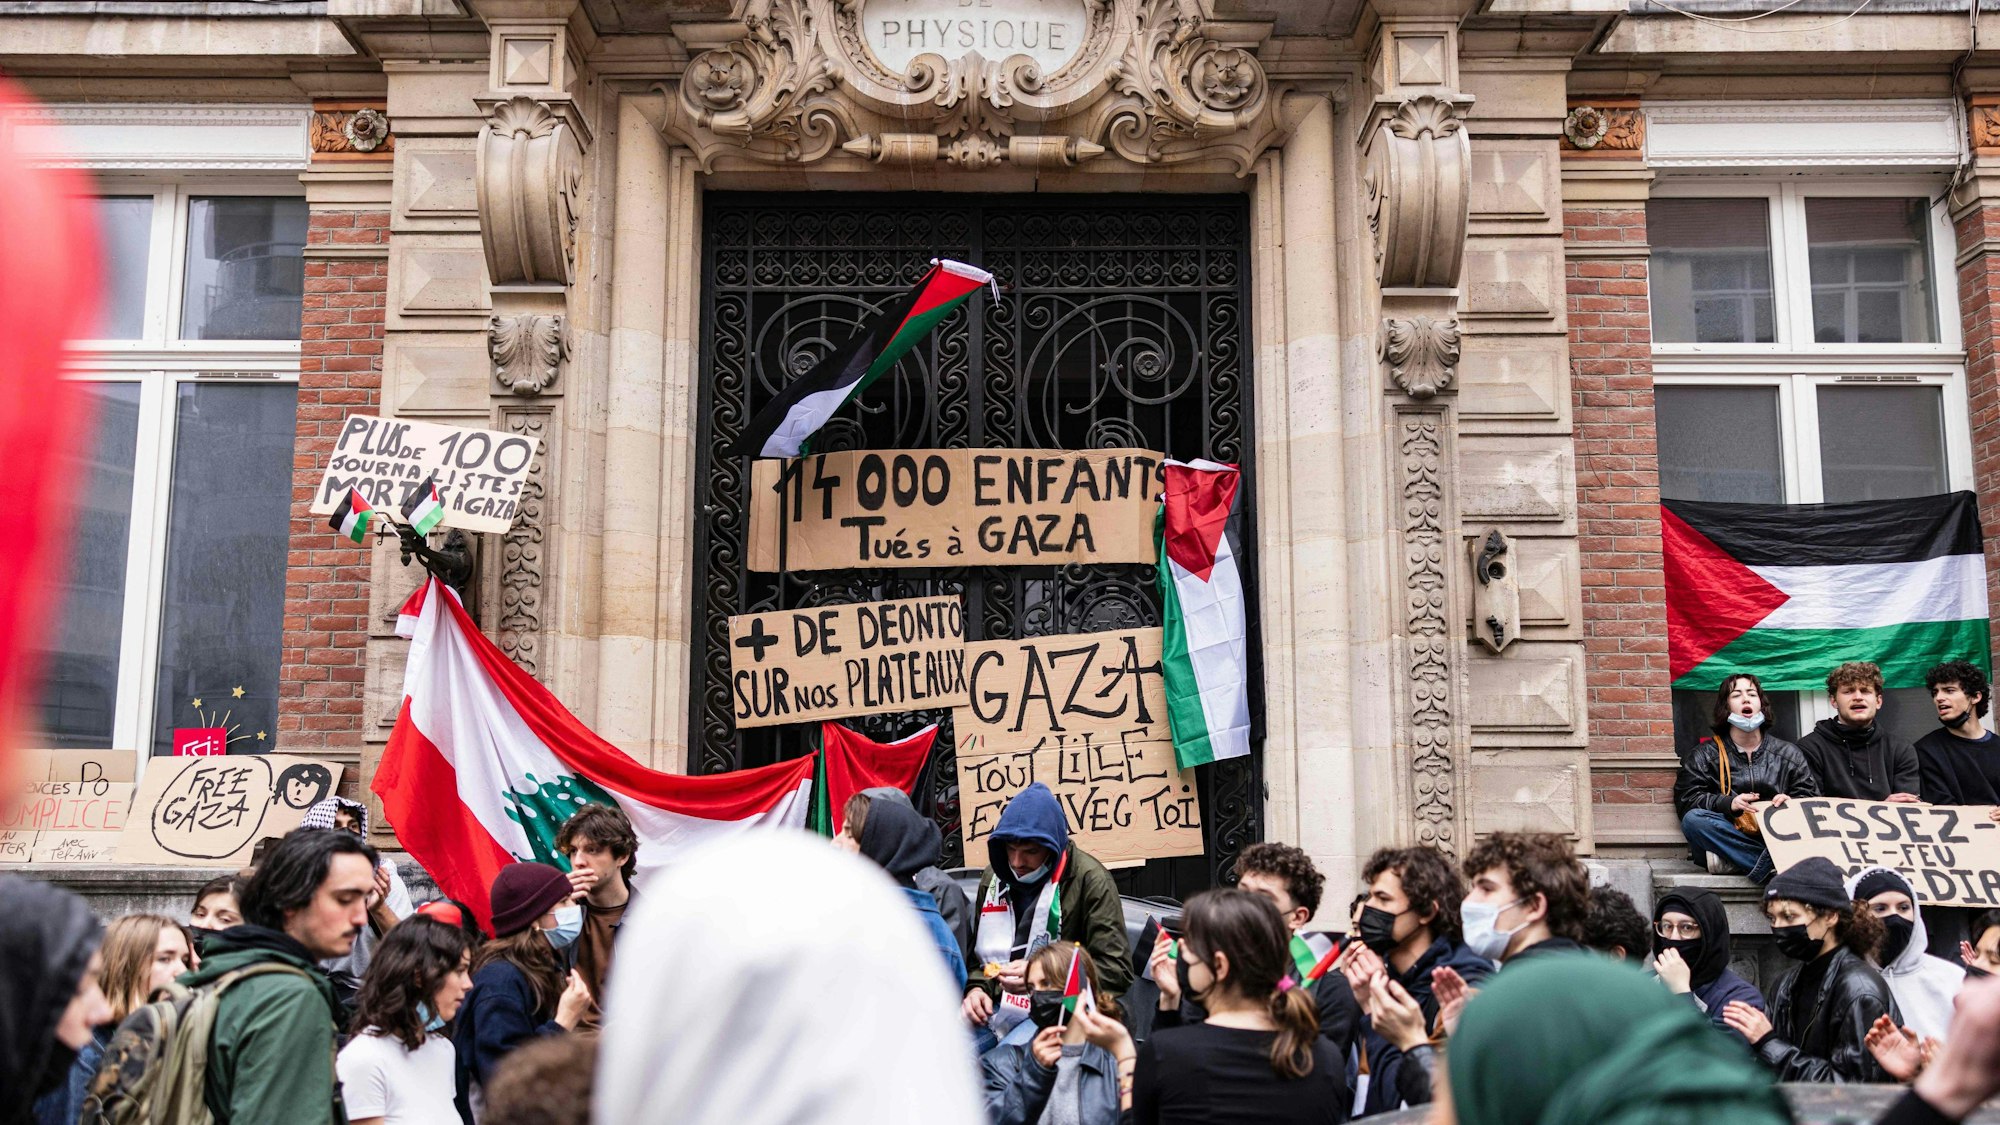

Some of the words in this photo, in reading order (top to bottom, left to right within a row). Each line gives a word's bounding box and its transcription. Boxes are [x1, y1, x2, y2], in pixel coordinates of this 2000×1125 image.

[881, 19, 1066, 50] PHYSIQUE
[338, 417, 411, 457] PLUS
[397, 446, 427, 460] DE
[439, 431, 532, 475] 100
[464, 497, 516, 521] GAZA
[773, 453, 841, 522] 14
[857, 454, 951, 511] 000
[948, 526, 964, 556] à
[978, 513, 1097, 556] GAZA
[793, 611, 842, 658] DE
[857, 602, 963, 650] DEONTO
[734, 667, 790, 719] SUR
[845, 649, 968, 708] PLATEAUX
[969, 636, 1164, 732] GAZA
[188, 767, 253, 803] FREE
[163, 794, 250, 832] GAZA
